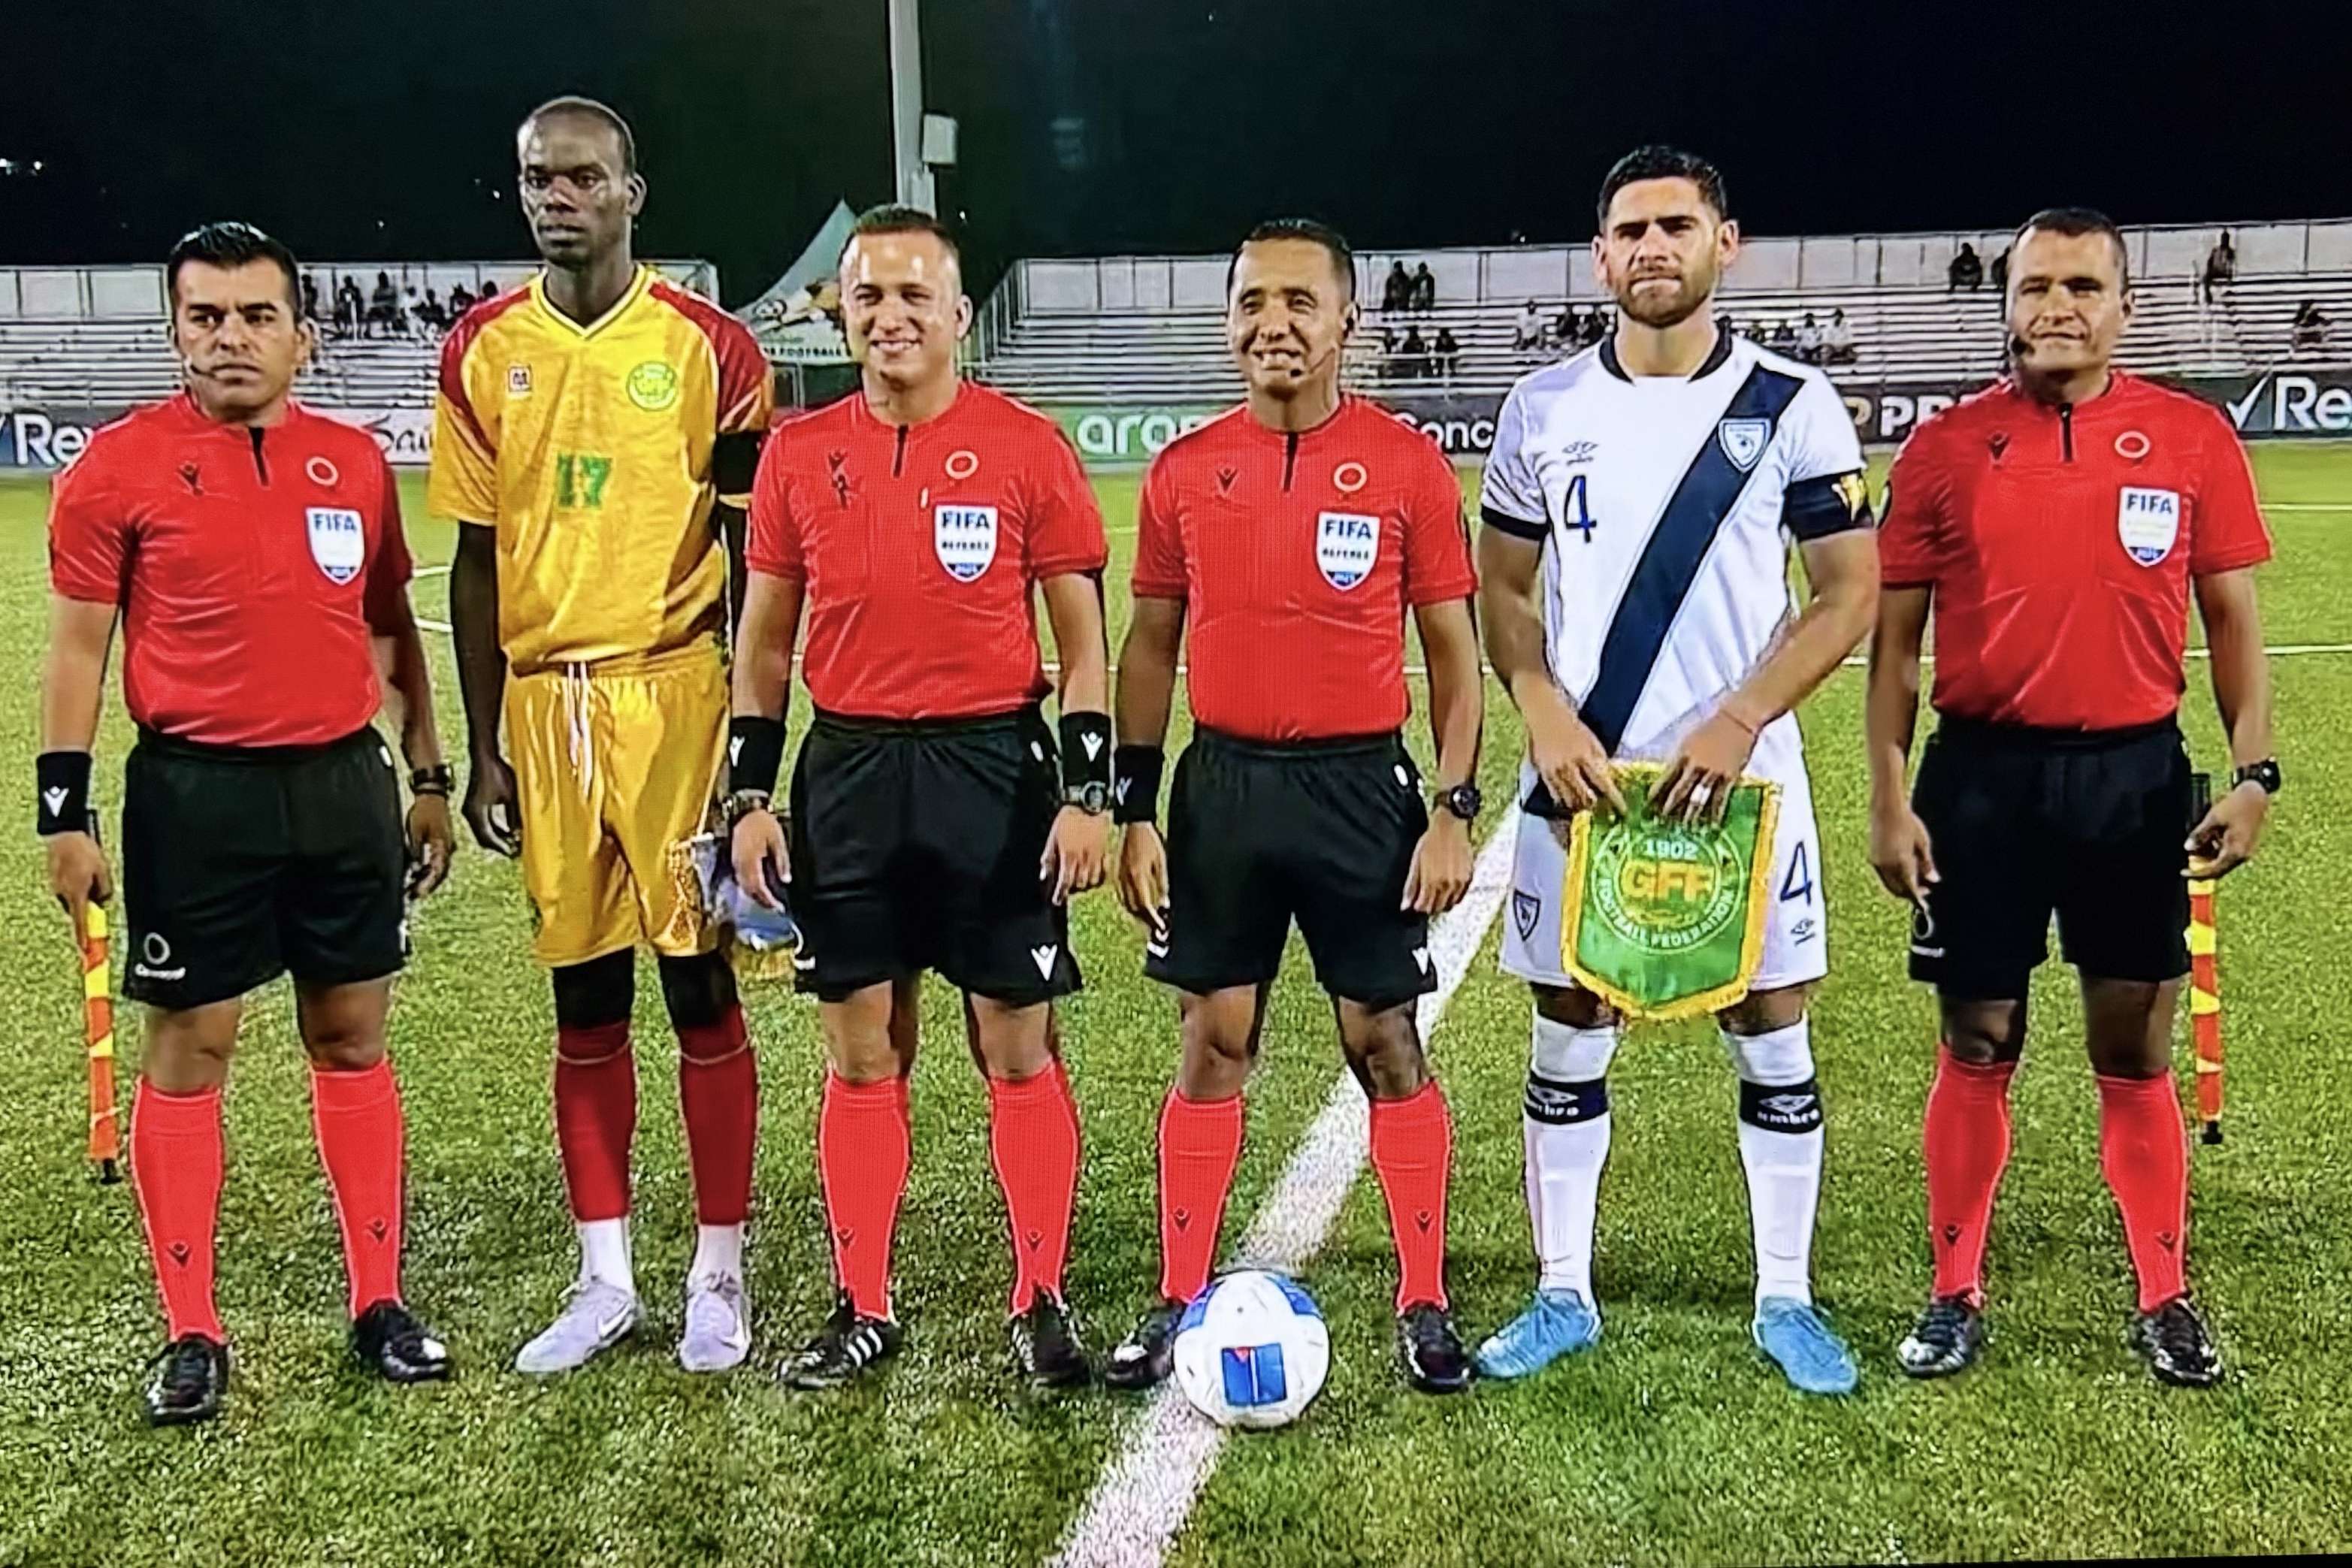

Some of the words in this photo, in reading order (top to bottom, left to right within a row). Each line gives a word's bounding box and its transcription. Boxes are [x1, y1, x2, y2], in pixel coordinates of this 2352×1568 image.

[557, 452, 612, 506] 17
[1564, 474, 1598, 543] 4
[2126, 493, 2172, 515] FIFA
[313, 513, 357, 532] FIFA
[942, 512, 990, 529] FIFA
[1325, 519, 1372, 539] FIFA
[1620, 859, 1716, 902] GFF
[1779, 840, 1812, 908] 4
